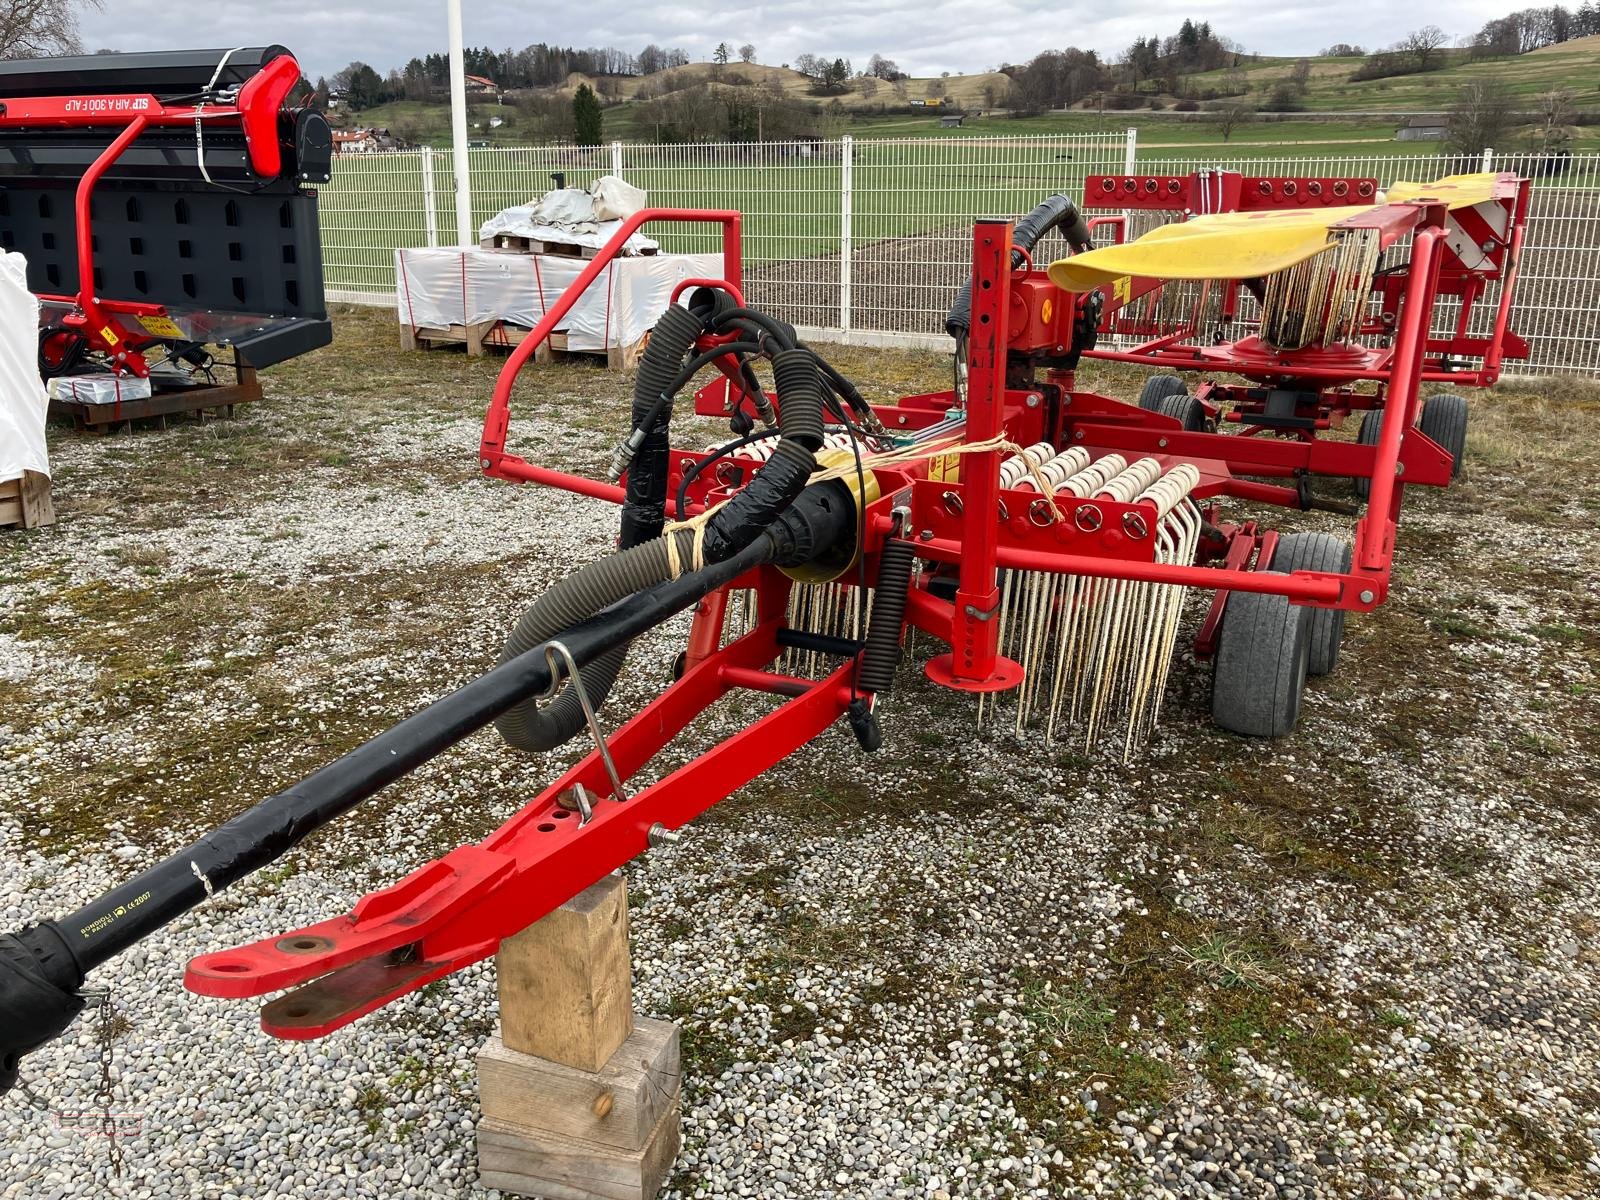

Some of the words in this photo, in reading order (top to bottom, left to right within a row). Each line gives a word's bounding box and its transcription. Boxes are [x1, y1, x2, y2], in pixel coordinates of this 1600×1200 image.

[65, 99, 82, 111] ALP
[82, 99, 88, 111] F
[88, 99, 107, 111] 300
[108, 99, 114, 110] A
[115, 99, 129, 110] AIR
[132, 98, 149, 110] SIP
[134, 891, 151, 906] 2007
[80, 913, 112, 934] BONDIOLI
[91, 918, 115, 933] PAVESI
